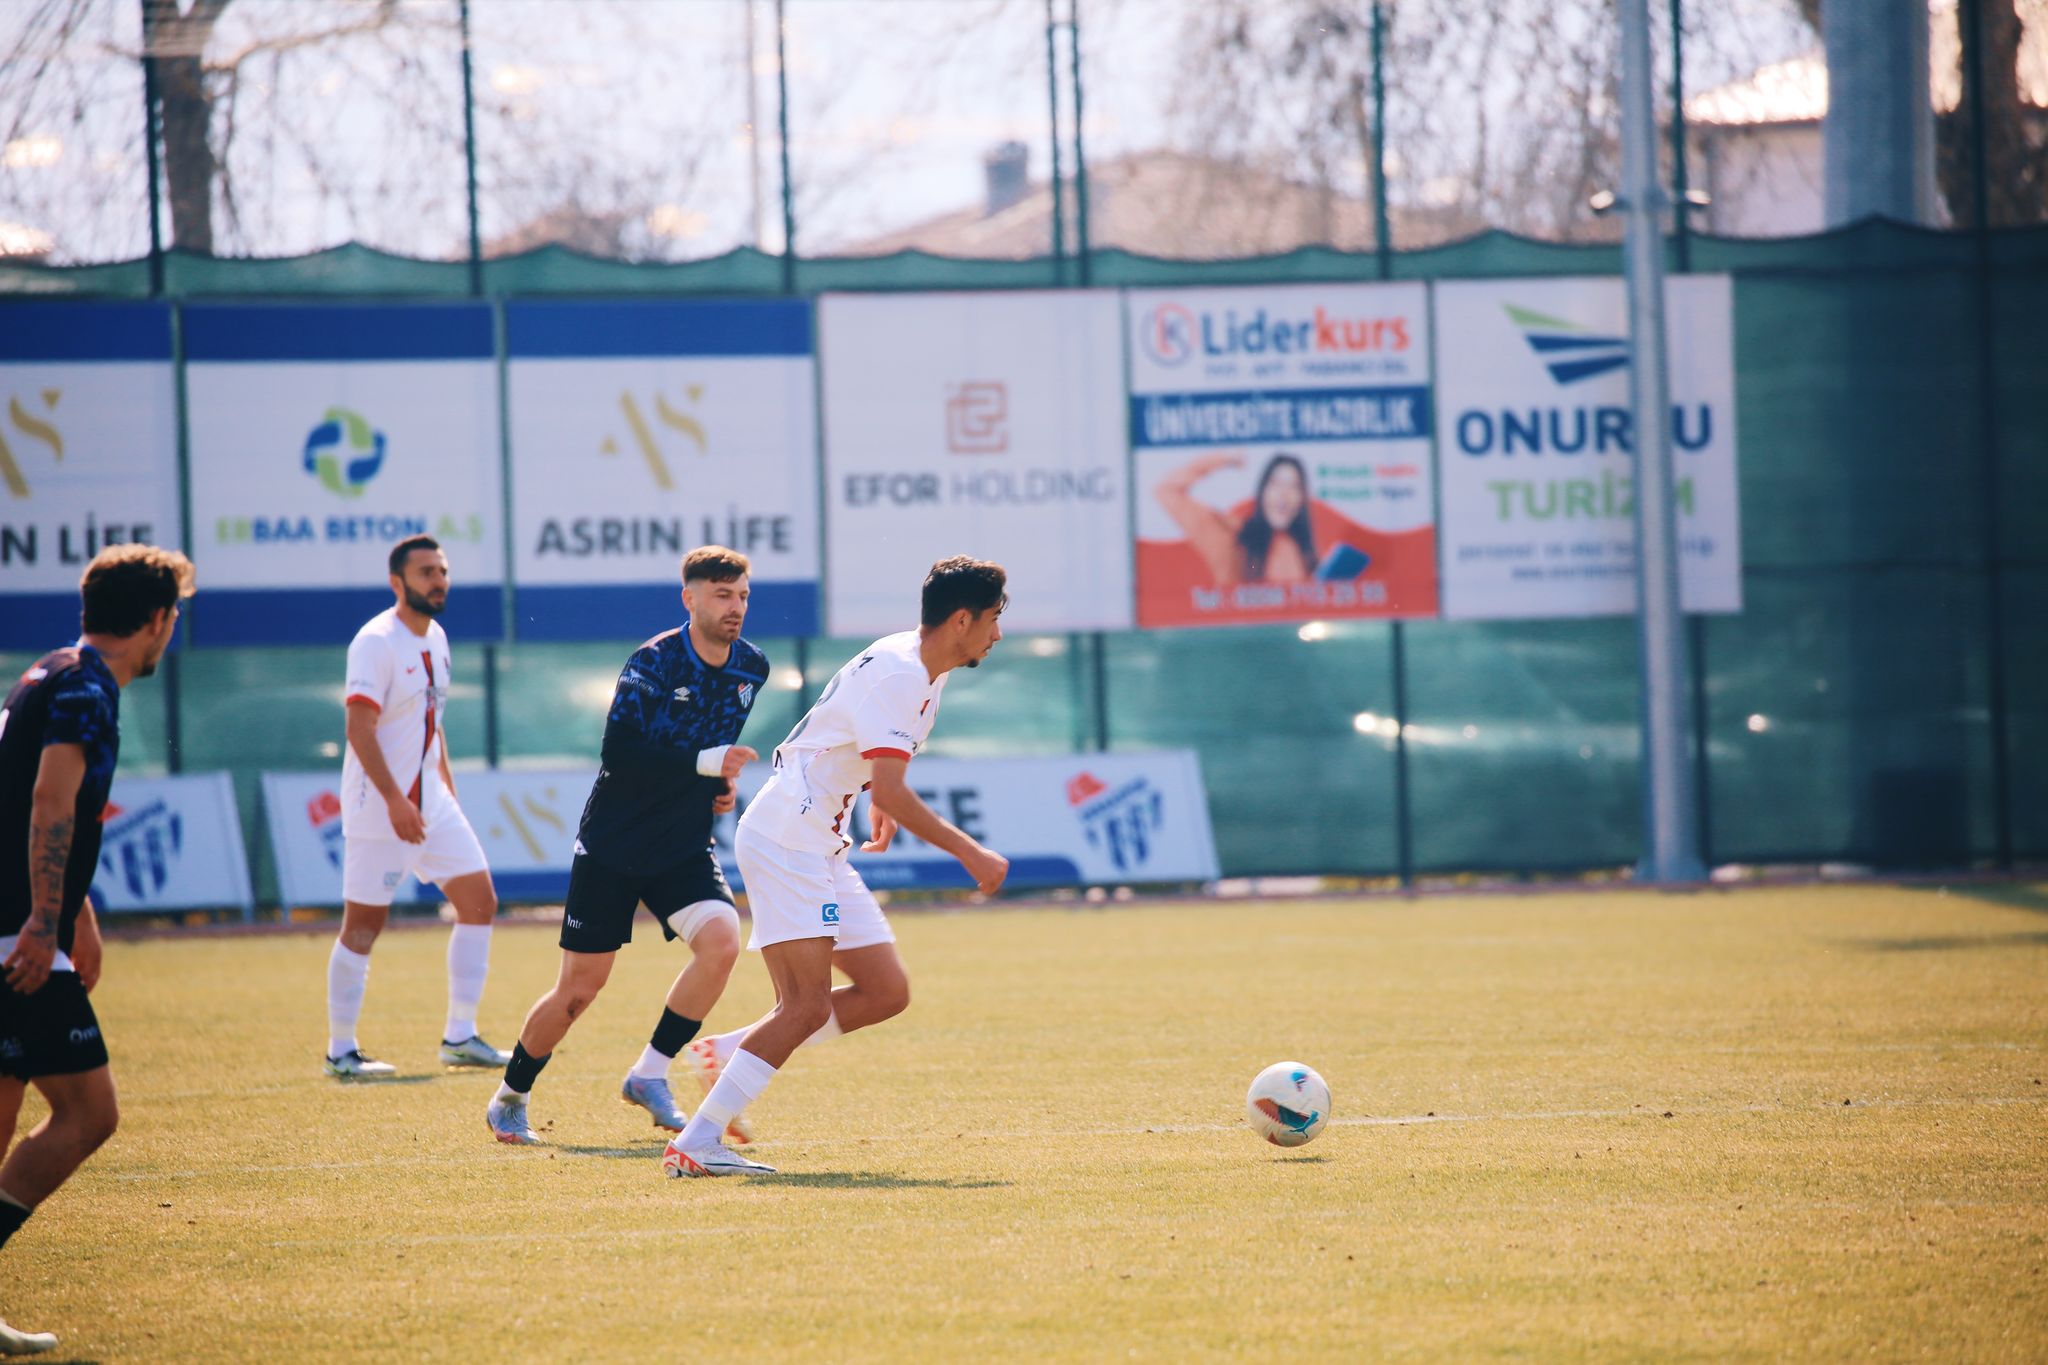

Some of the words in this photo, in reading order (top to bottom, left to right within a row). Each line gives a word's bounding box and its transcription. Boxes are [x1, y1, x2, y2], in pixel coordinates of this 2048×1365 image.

[1203, 304, 1411, 355] Liderkurs
[1456, 404, 1711, 455] ONURU
[844, 472, 940, 508] EFOR
[951, 466, 1117, 505] HOLDING
[536, 517, 684, 557] ASRIN
